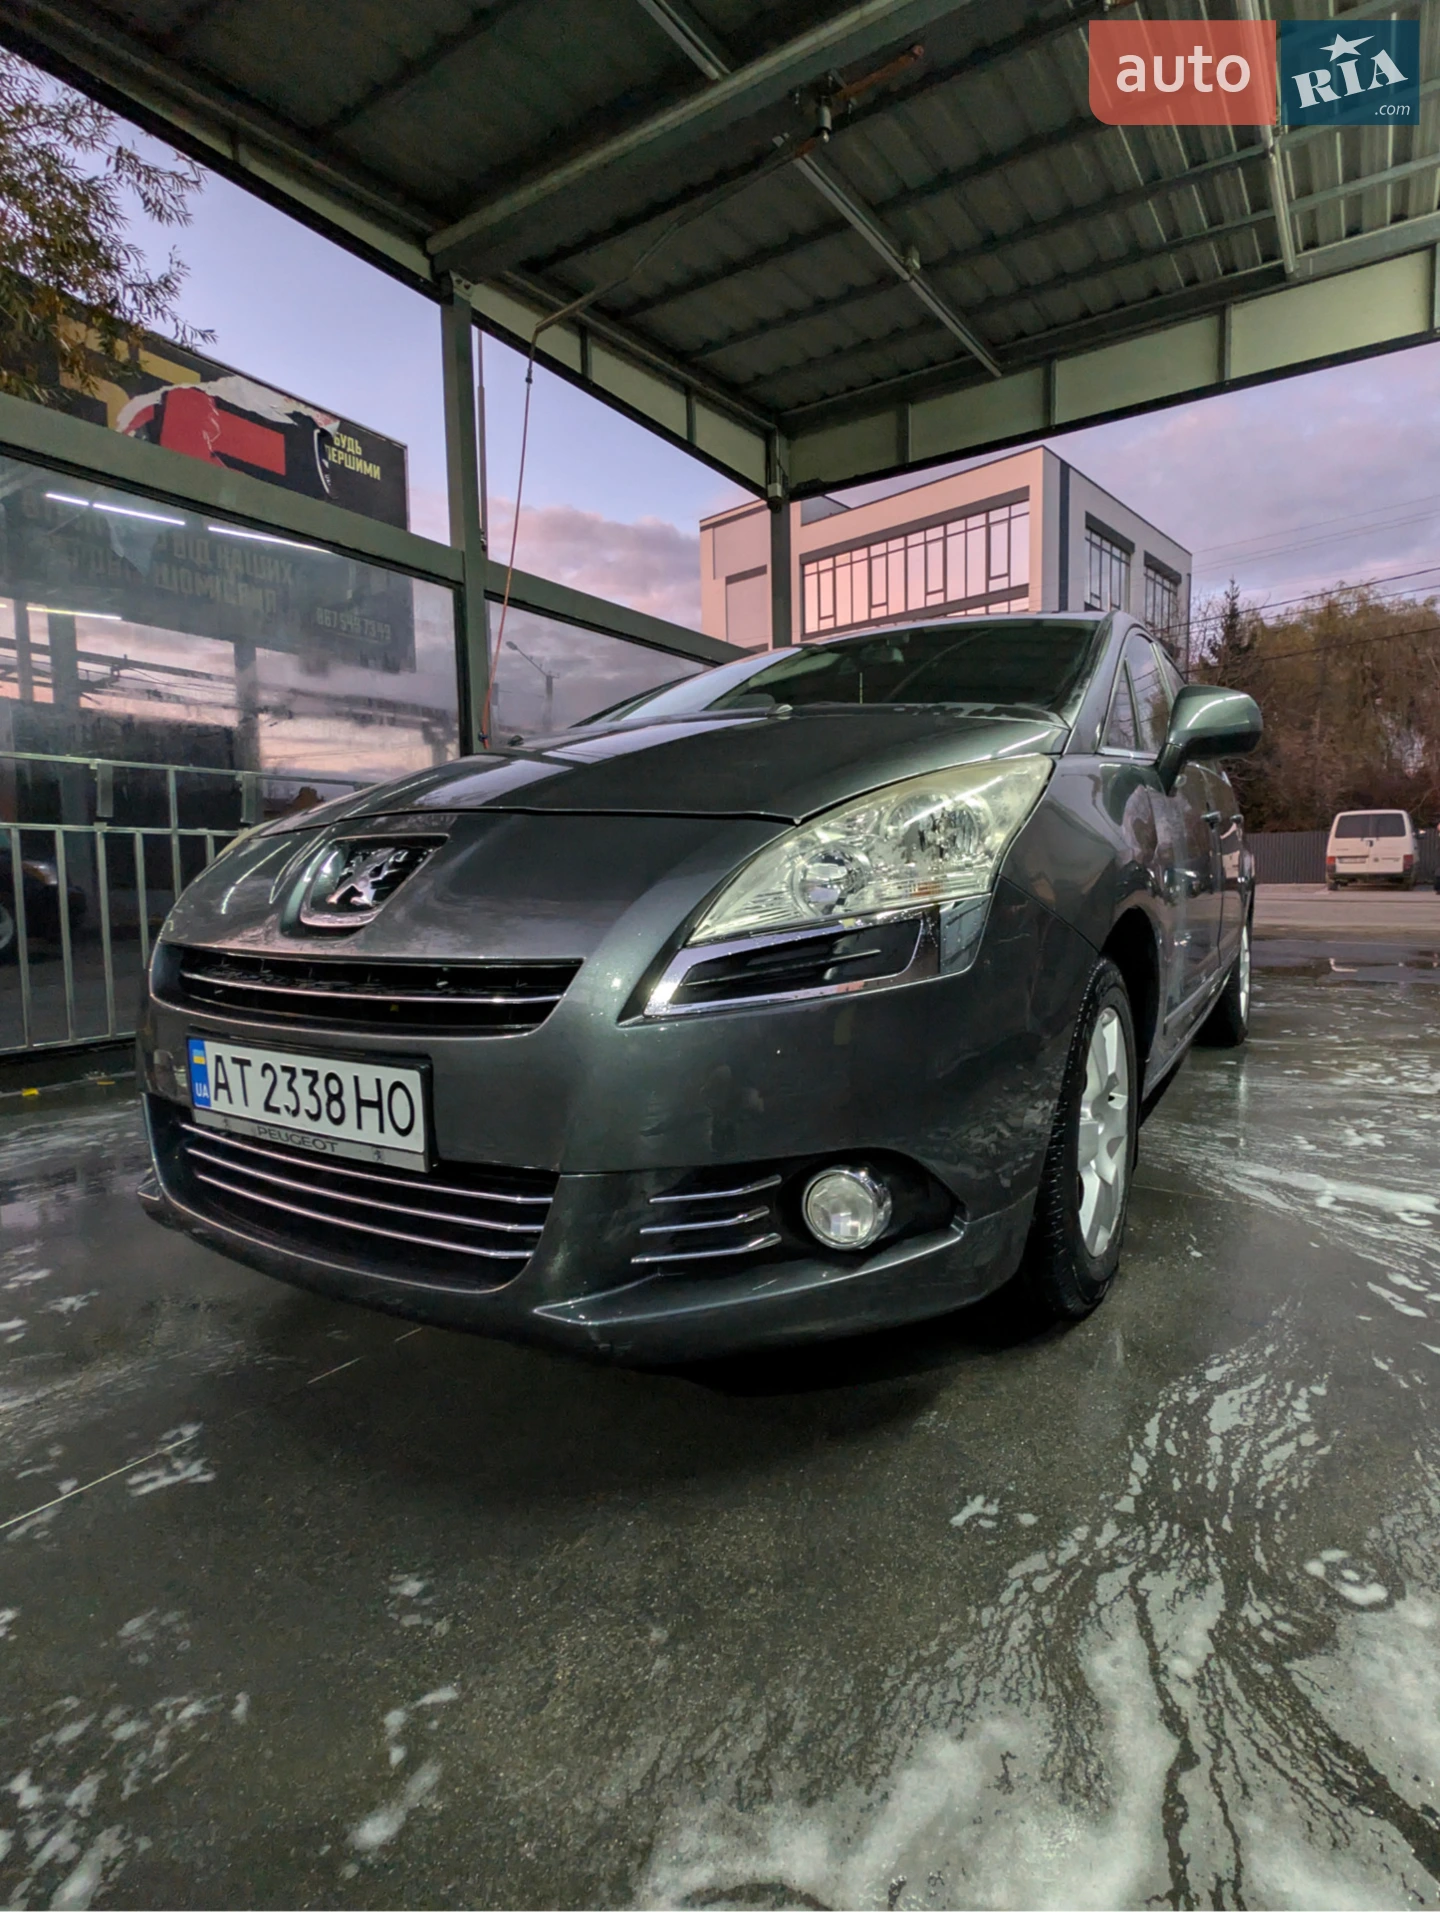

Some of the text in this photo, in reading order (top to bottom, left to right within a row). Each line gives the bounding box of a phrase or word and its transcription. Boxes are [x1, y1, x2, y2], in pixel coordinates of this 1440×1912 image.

[333, 431, 363, 456] БУДЬ
[195, 1083, 210, 1099] UA
[213, 1054, 415, 1138] AT 2338 HO
[256, 1125, 339, 1153] PEUGEOT
